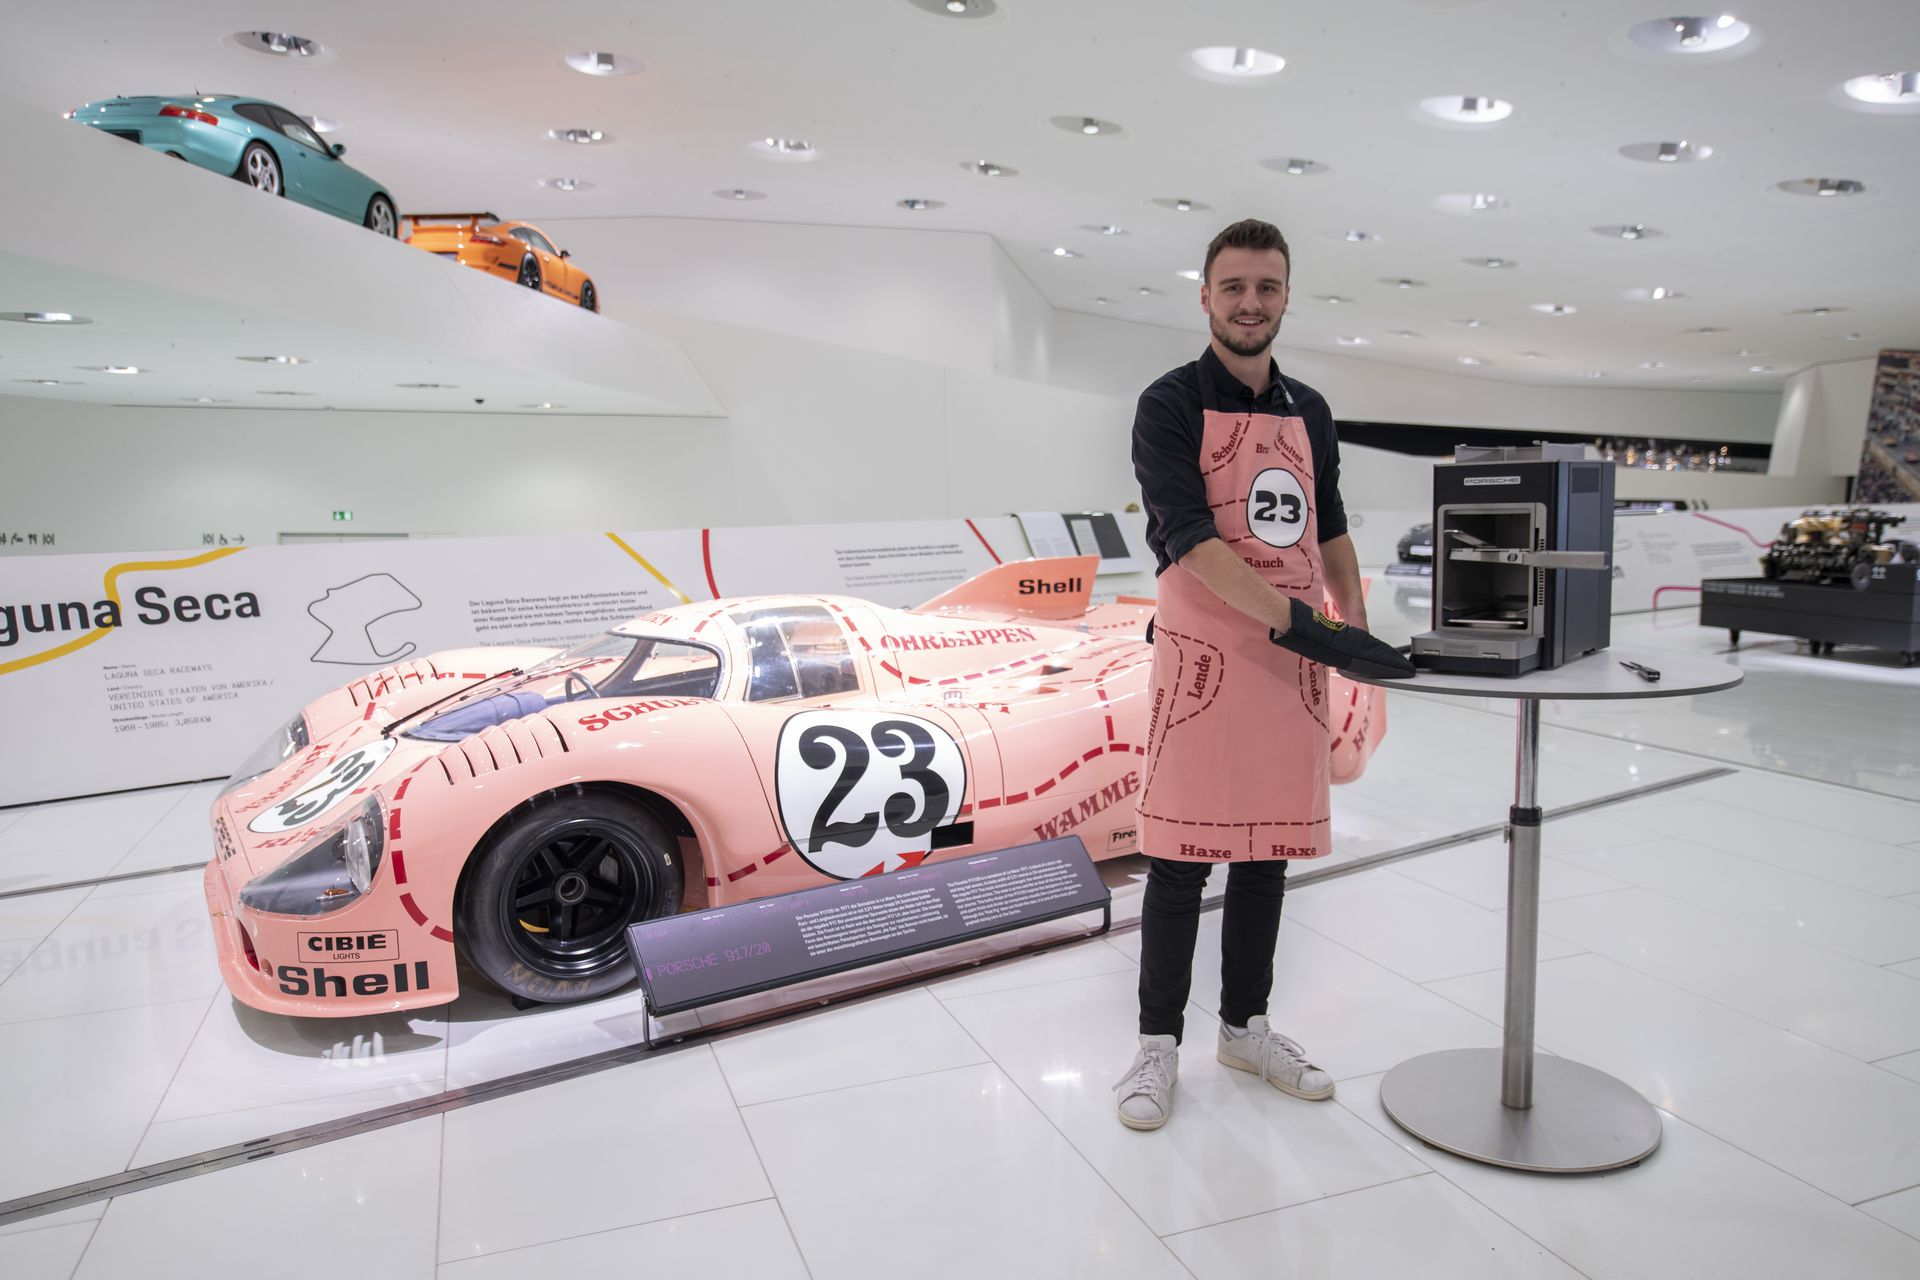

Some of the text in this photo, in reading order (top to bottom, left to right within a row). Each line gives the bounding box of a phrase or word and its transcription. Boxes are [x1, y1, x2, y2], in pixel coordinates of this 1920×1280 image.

[1211, 420, 1242, 463] Schulter
[1465, 477, 1520, 485] PORSCHE
[1254, 490, 1302, 523] 23
[1244, 556, 1284, 568] Bauch
[1019, 578, 1081, 595] Shell
[135, 586, 261, 626] Seca
[1187, 654, 1212, 700] Lende
[1309, 662, 1321, 706] Lende
[274, 750, 376, 826] 23
[799, 720, 950, 853] 23
[1034, 771, 1141, 841] WAMME
[1180, 844, 1232, 859] Haxe
[1271, 845, 1316, 857] Haxe
[333, 952, 360, 960] LIGHTS
[656, 941, 772, 977] PORSCHE 917/20
[278, 961, 430, 997] Shell
